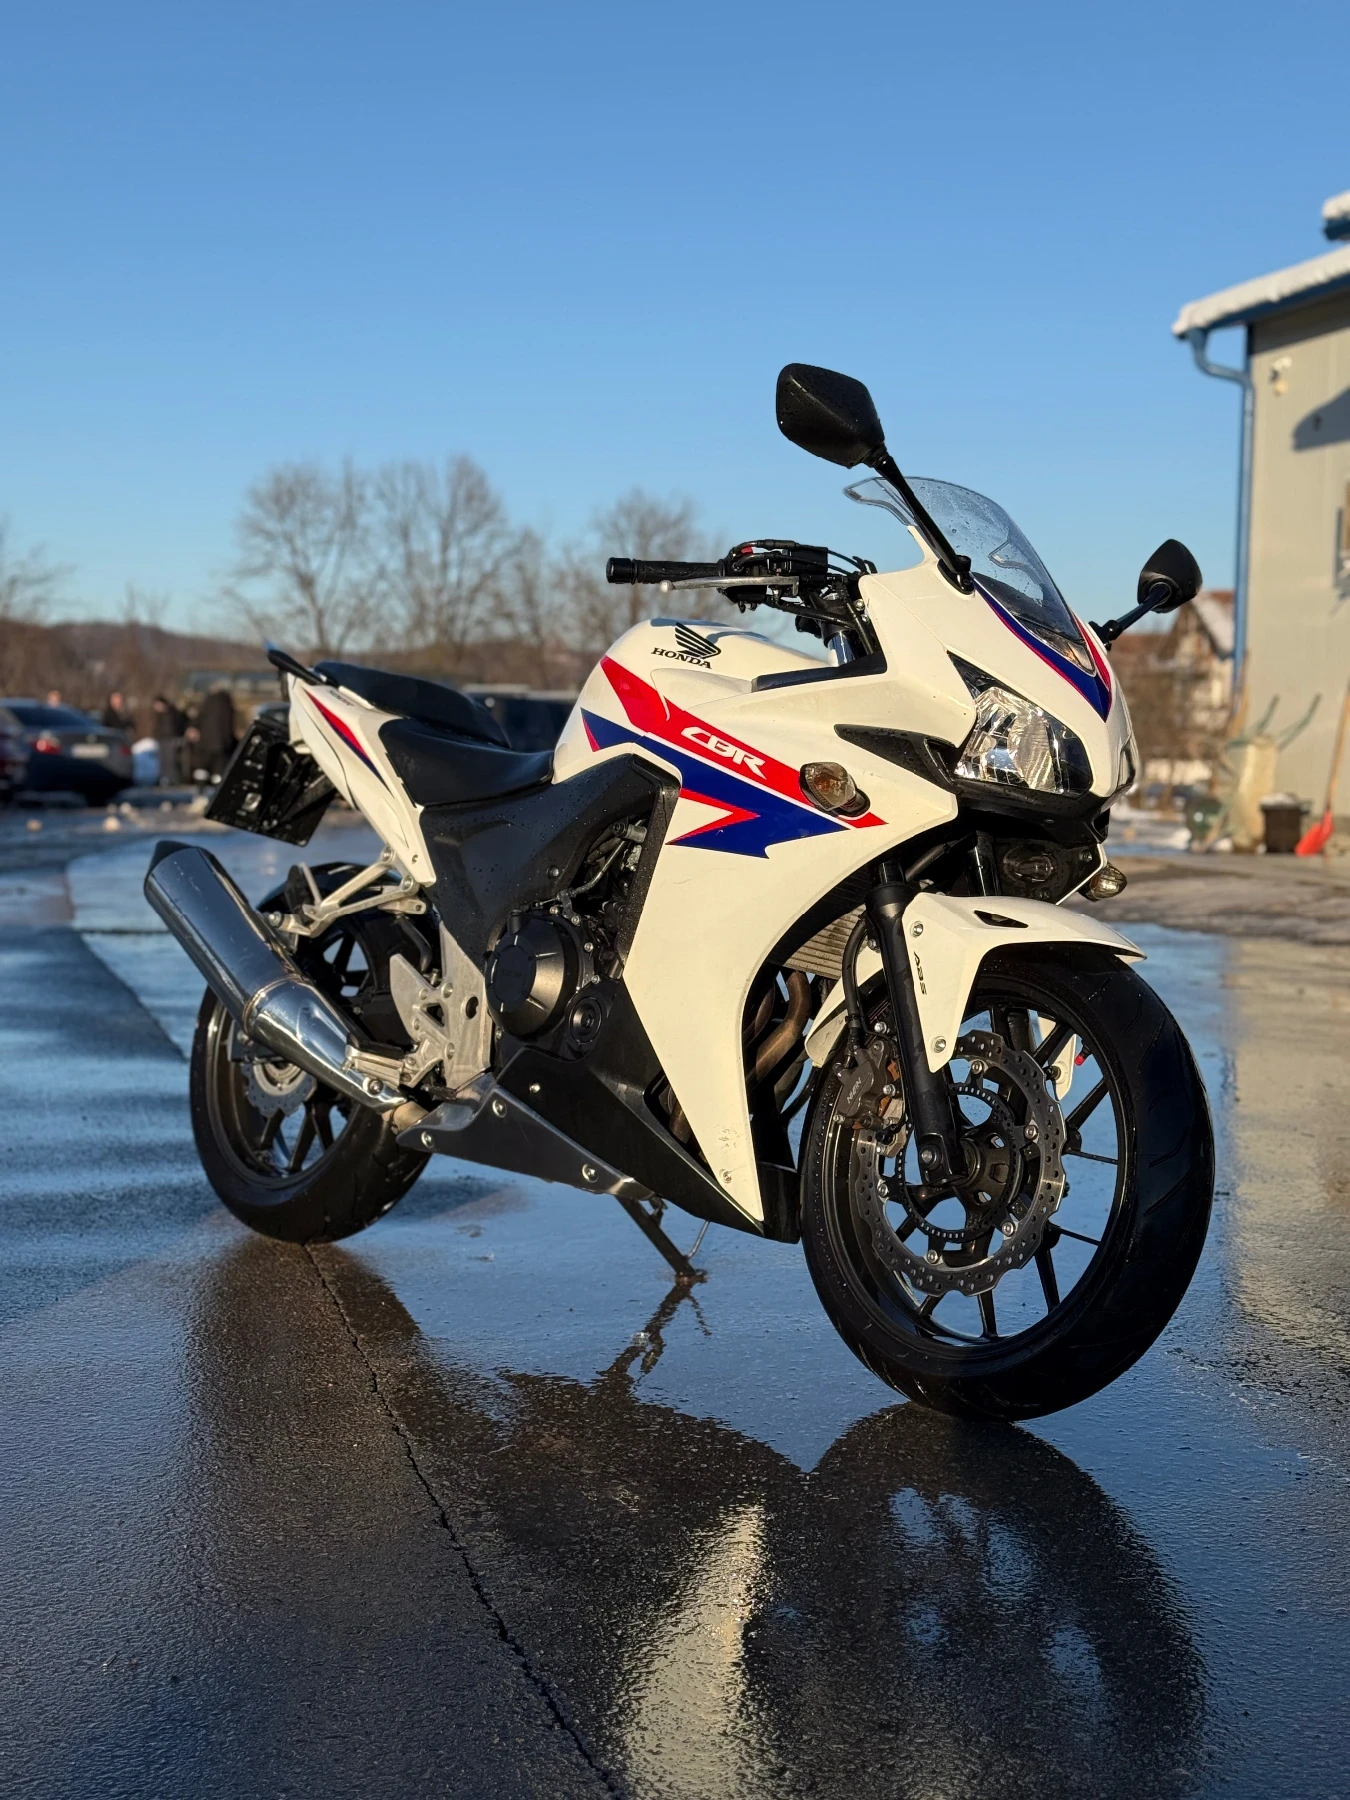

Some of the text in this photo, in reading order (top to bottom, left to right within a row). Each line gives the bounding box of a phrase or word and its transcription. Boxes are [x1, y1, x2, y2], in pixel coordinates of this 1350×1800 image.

[651, 647, 712, 669] HONDA
[681, 727, 767, 780] CBR
[913, 950, 928, 996] ABS
